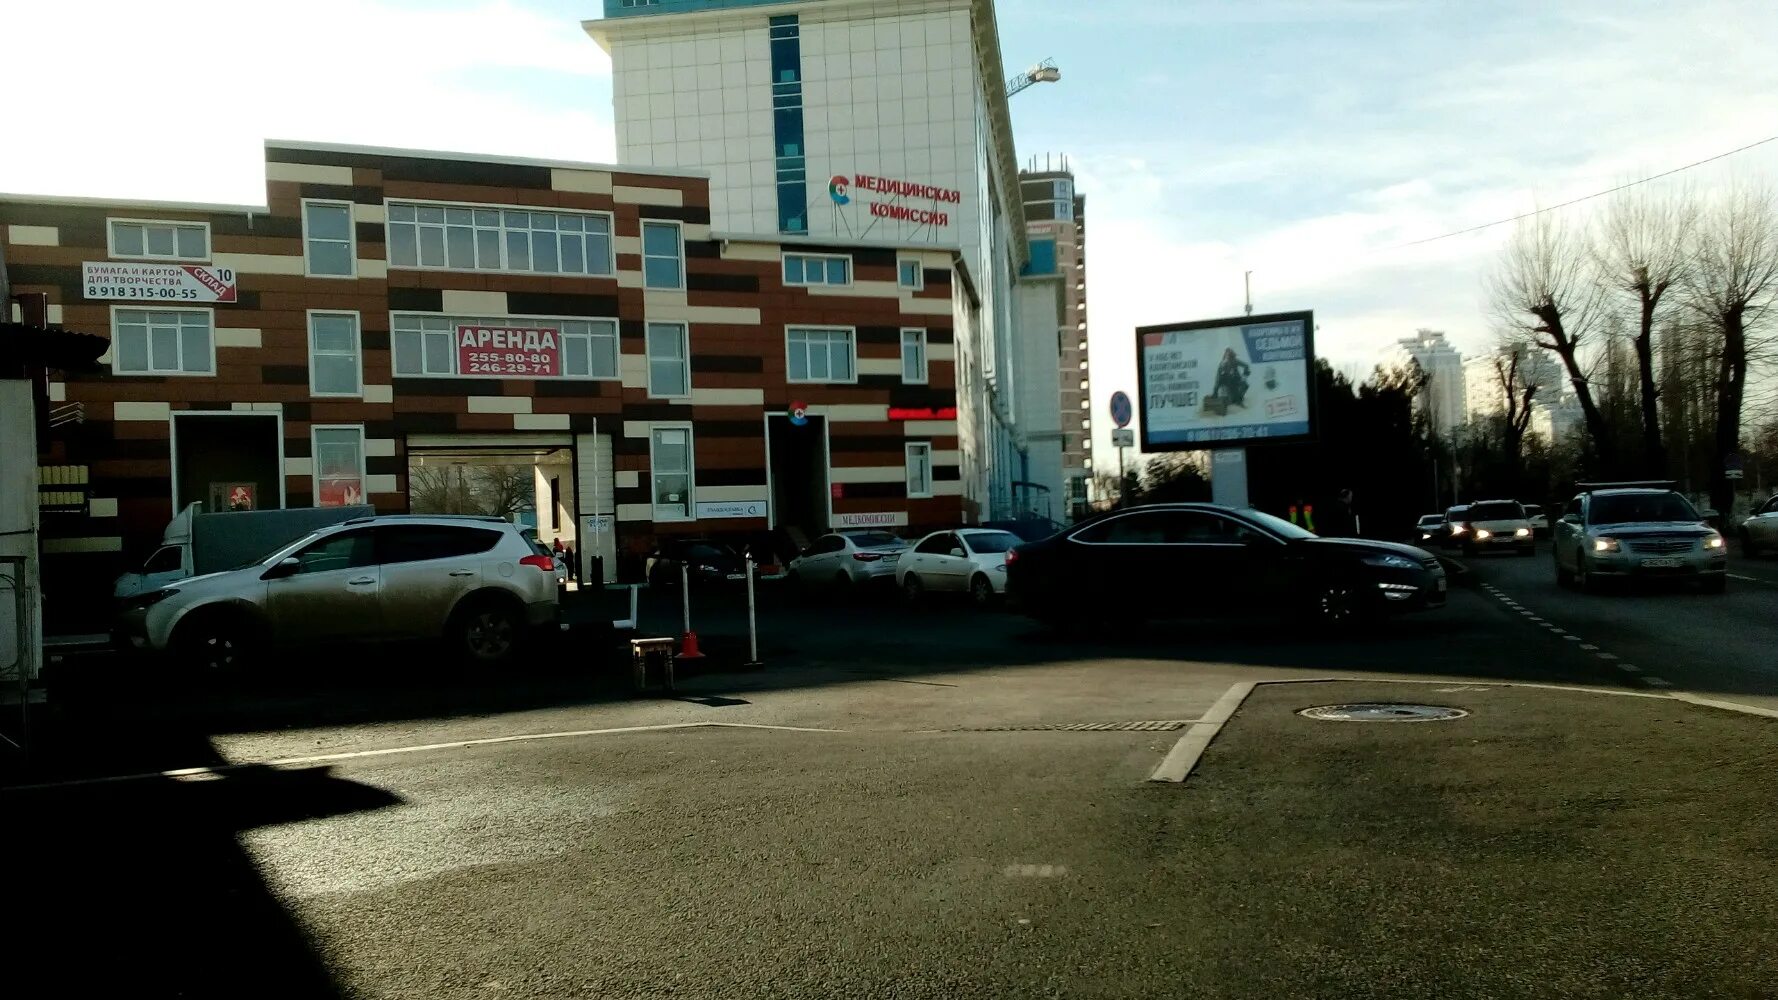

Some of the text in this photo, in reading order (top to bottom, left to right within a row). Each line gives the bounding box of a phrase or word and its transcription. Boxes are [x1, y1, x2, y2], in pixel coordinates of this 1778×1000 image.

[854, 174, 960, 204] МЕДИЦИНСКАЯ
[870, 202, 948, 226] КОМИССИЯ
[87, 266, 128, 275] БУМАГА
[142, 269, 183, 277] КАРТОН
[216, 269, 232, 281] 10
[87, 276, 182, 286] ДЛЯ ТВОРЧЕСТВА
[193, 268, 227, 297] СКЛАД
[88, 286, 197, 299] 8 918 315-00-55
[460, 329, 557, 352] АРЕНДА
[468, 352, 551, 363] 255-80-80
[469, 363, 551, 374] 246-29-71
